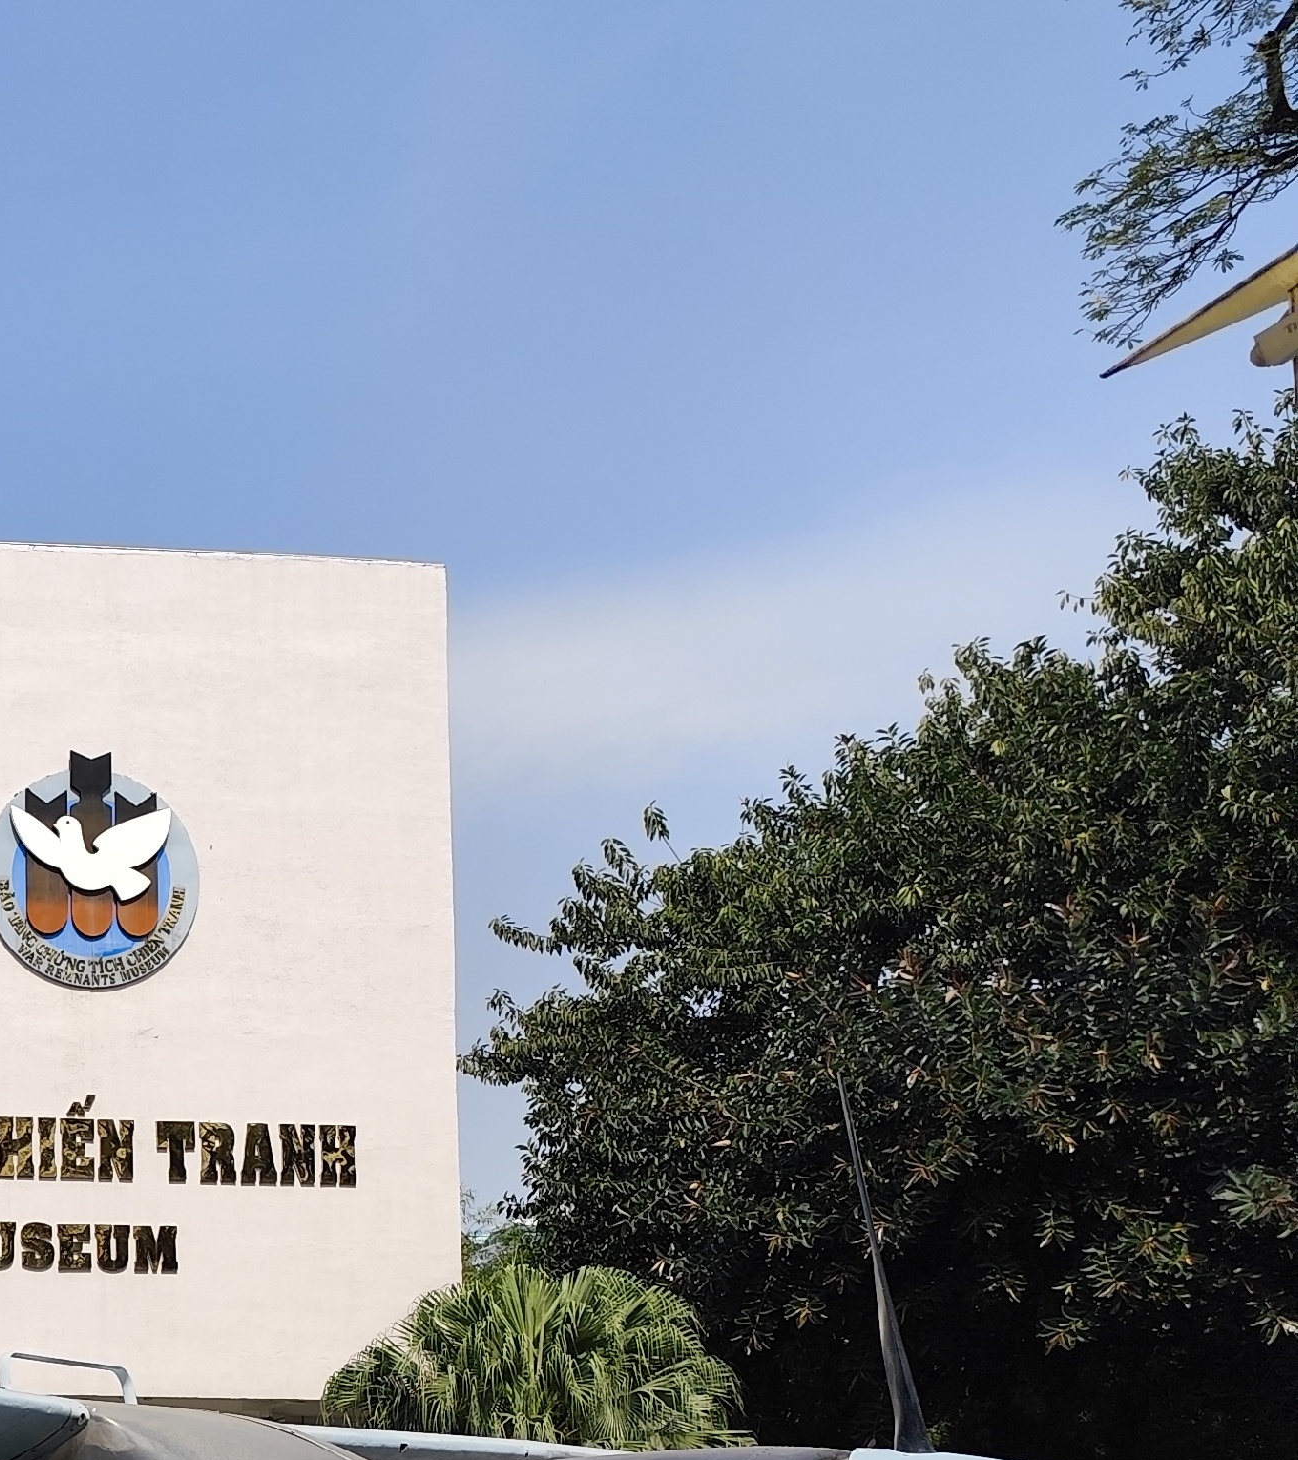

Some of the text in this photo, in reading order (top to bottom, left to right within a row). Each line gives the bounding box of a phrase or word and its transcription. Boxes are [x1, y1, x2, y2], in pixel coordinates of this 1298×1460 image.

[17, 943, 44, 970] WAR
[119, 947, 170, 982] MUSEUM
[87, 956, 125, 974] TÍCH
[157, 886, 186, 935] TRANH
[155, 1119, 357, 1188] TRANH
